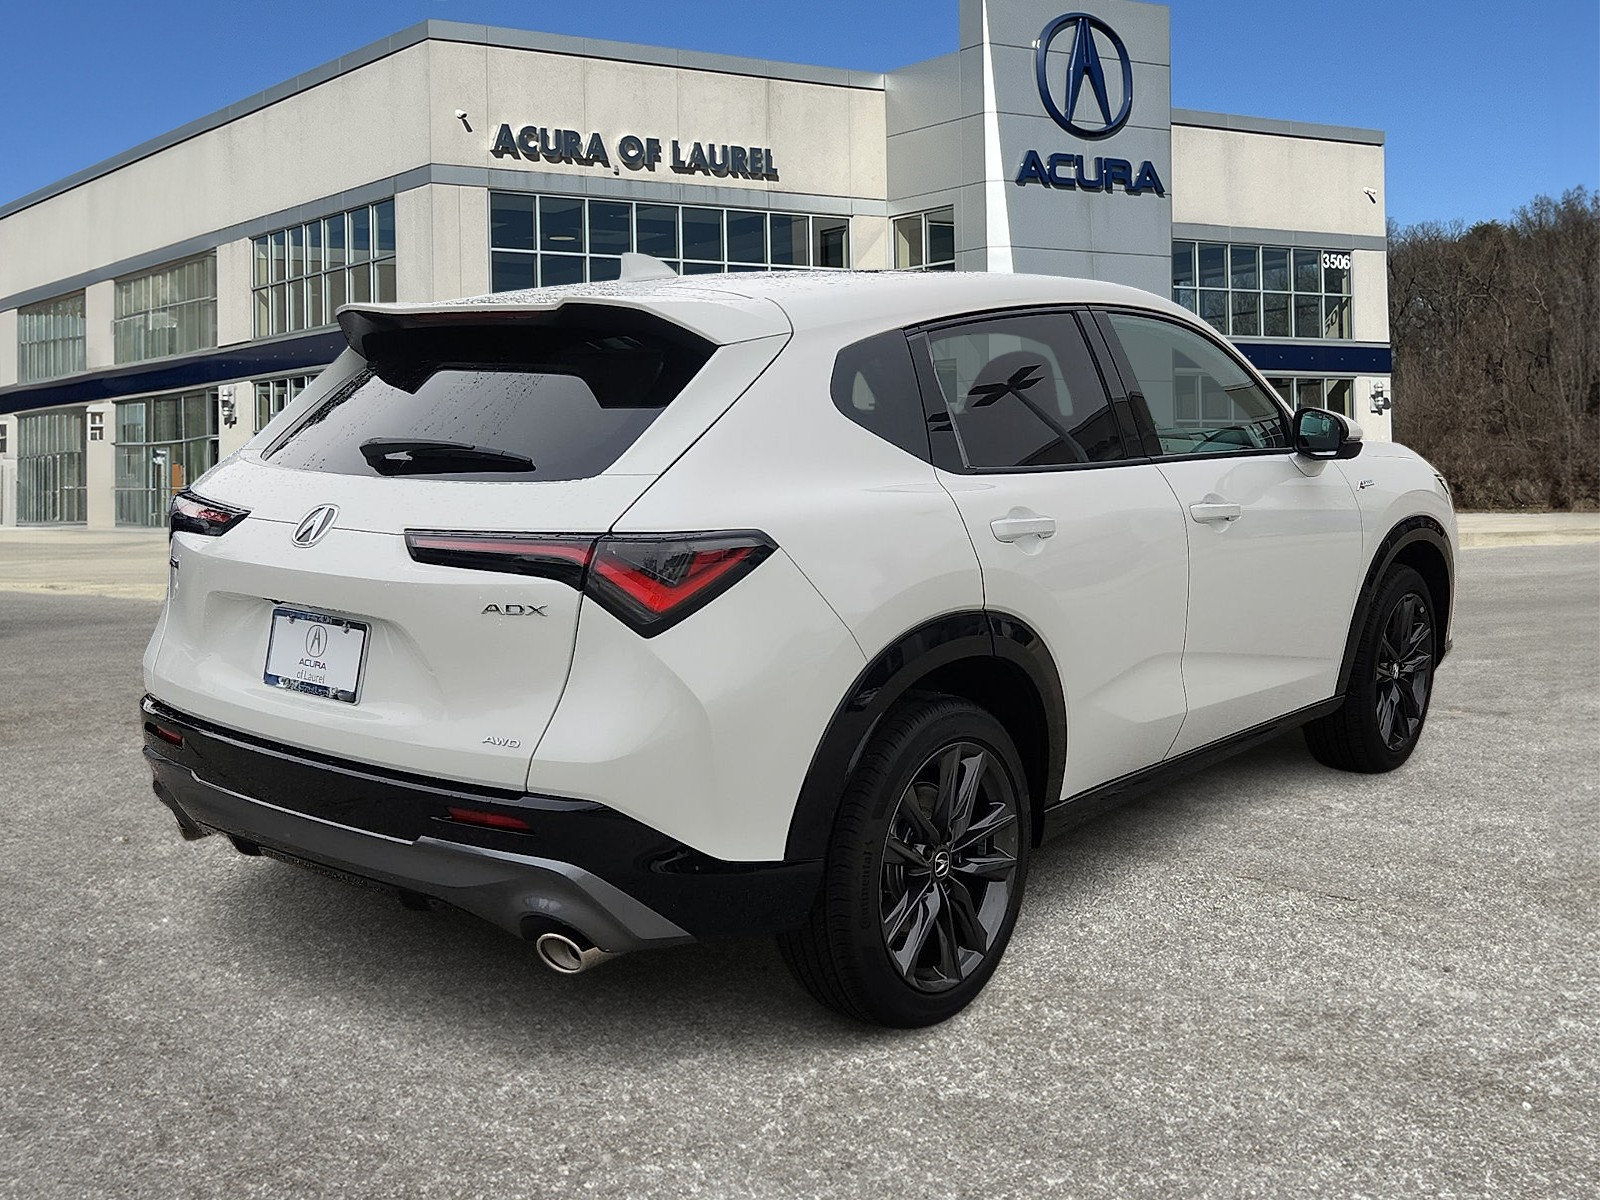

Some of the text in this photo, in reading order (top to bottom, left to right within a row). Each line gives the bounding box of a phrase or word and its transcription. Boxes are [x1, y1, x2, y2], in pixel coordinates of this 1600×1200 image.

[491, 123, 779, 182] ACURA OF LAUREL
[1016, 149, 1166, 198] ACURA
[1322, 253, 1351, 270] 3506
[481, 603, 549, 617] ADX
[299, 658, 327, 670] ACURA
[482, 736, 521, 749] AWD
